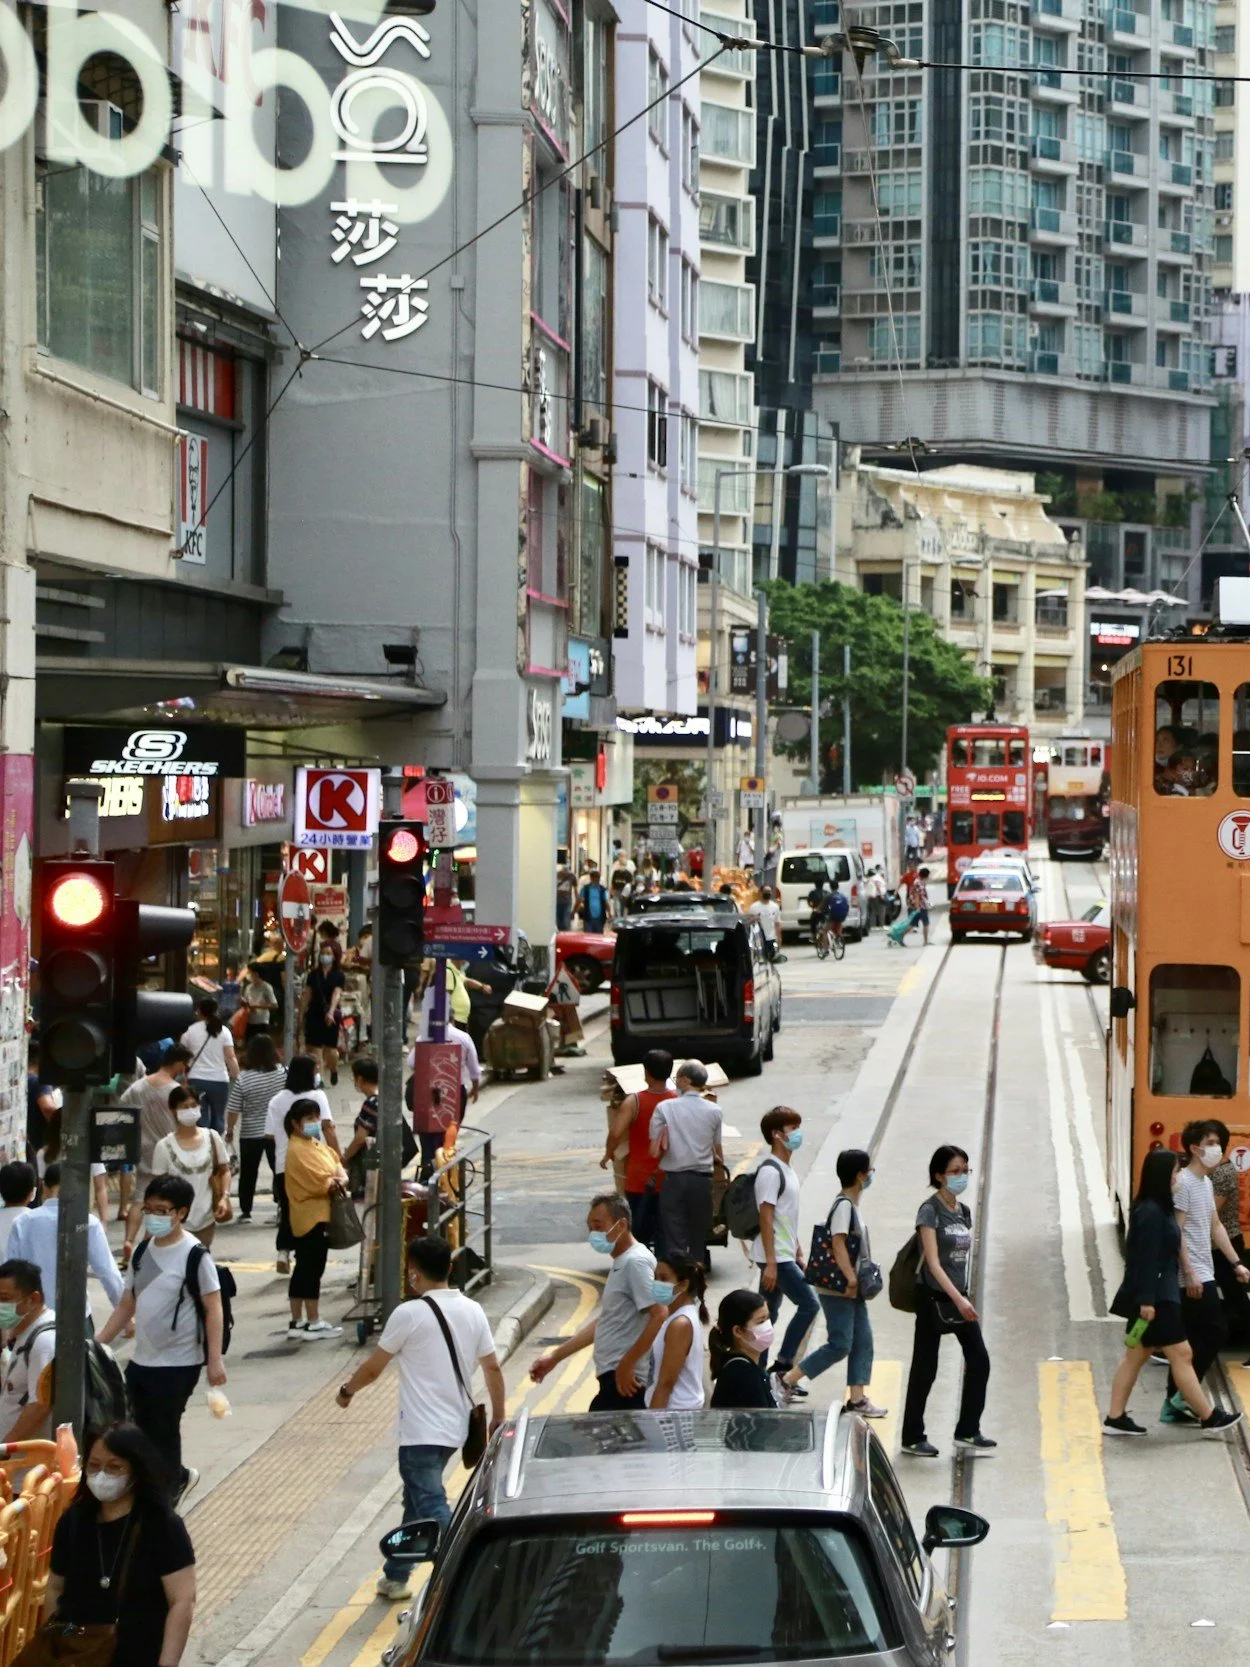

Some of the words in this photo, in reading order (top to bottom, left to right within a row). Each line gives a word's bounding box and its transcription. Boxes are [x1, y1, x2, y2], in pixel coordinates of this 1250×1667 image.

[184, 529, 203, 557] KFC
[1167, 655, 1193, 678] 131
[89, 759, 219, 776] SKECHERS
[428, 809, 448, 844] 灣仔
[300, 833, 373, 846] 24小時營業
[575, 1542, 607, 1555] Golf
[610, 1541, 689, 1556] Sportsvan.
[693, 1539, 720, 1551] The
